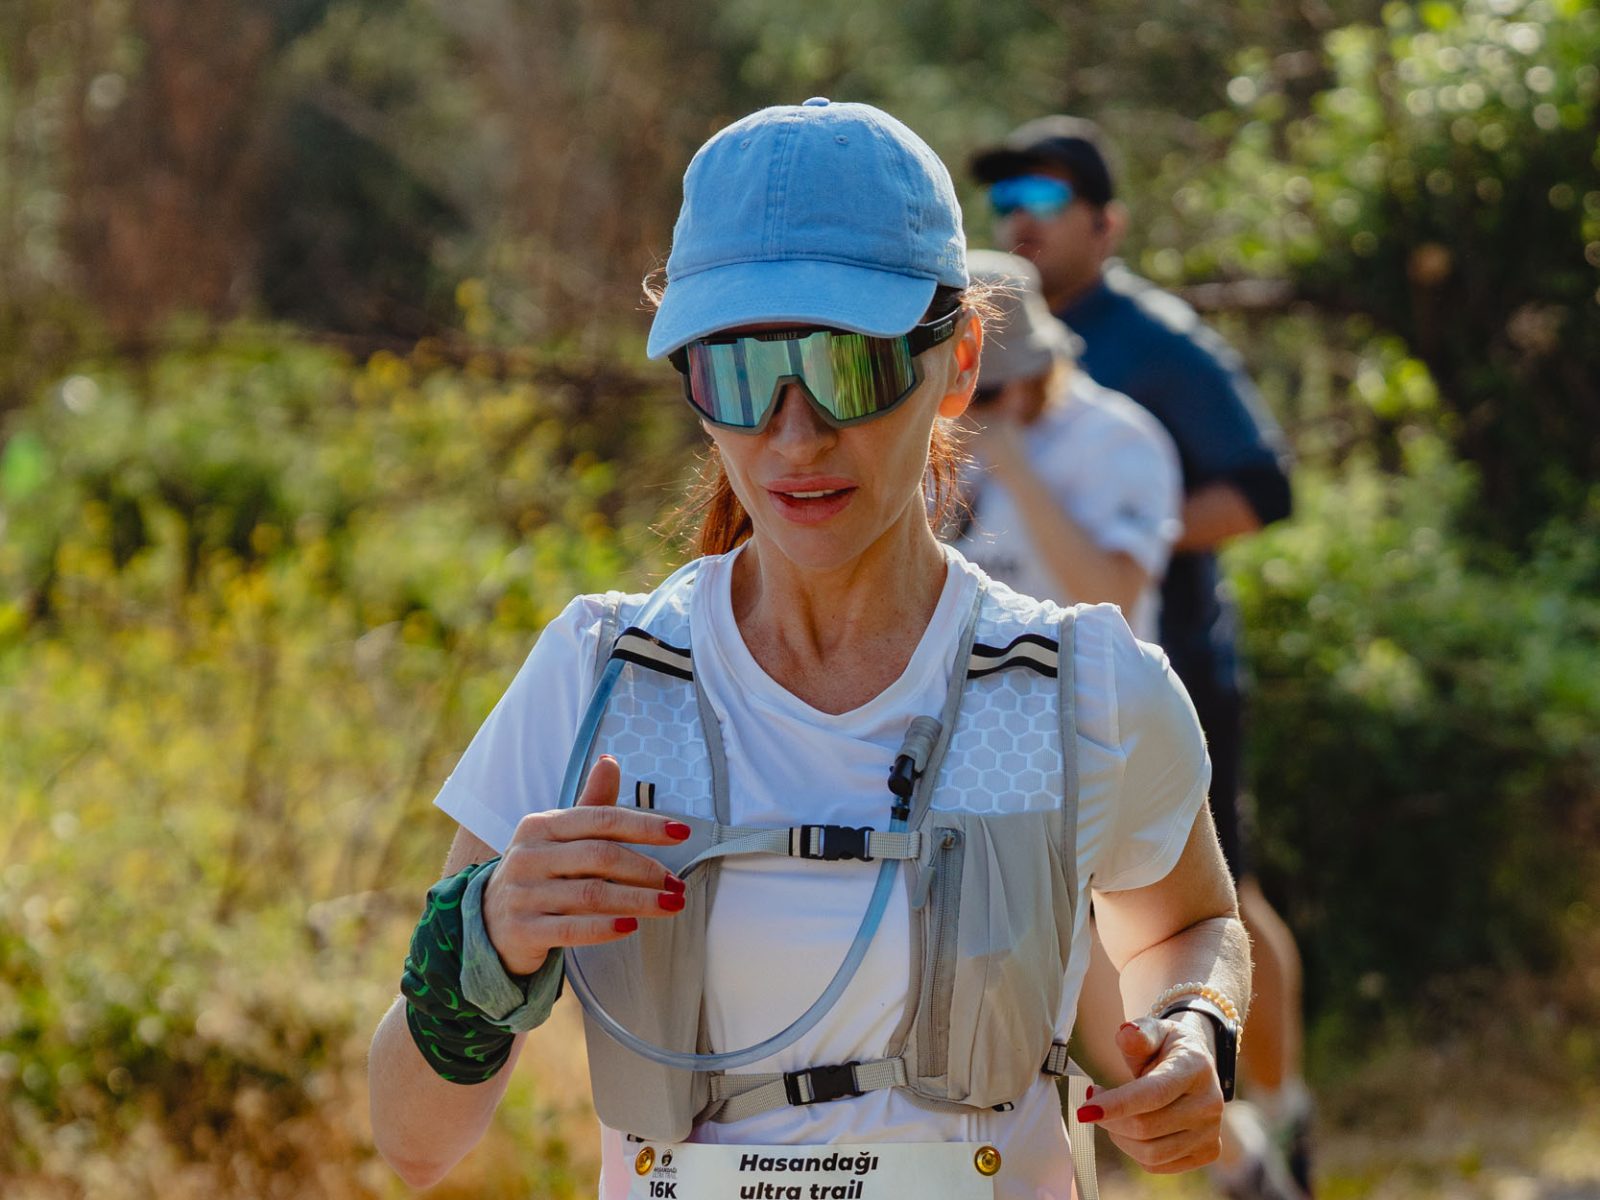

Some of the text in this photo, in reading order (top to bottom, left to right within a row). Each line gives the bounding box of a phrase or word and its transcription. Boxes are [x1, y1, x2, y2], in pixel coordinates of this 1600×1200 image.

[739, 1151, 879, 1175] Hasandağı
[650, 1181, 677, 1199] 16K
[740, 1179, 863, 1200] ultra trail
